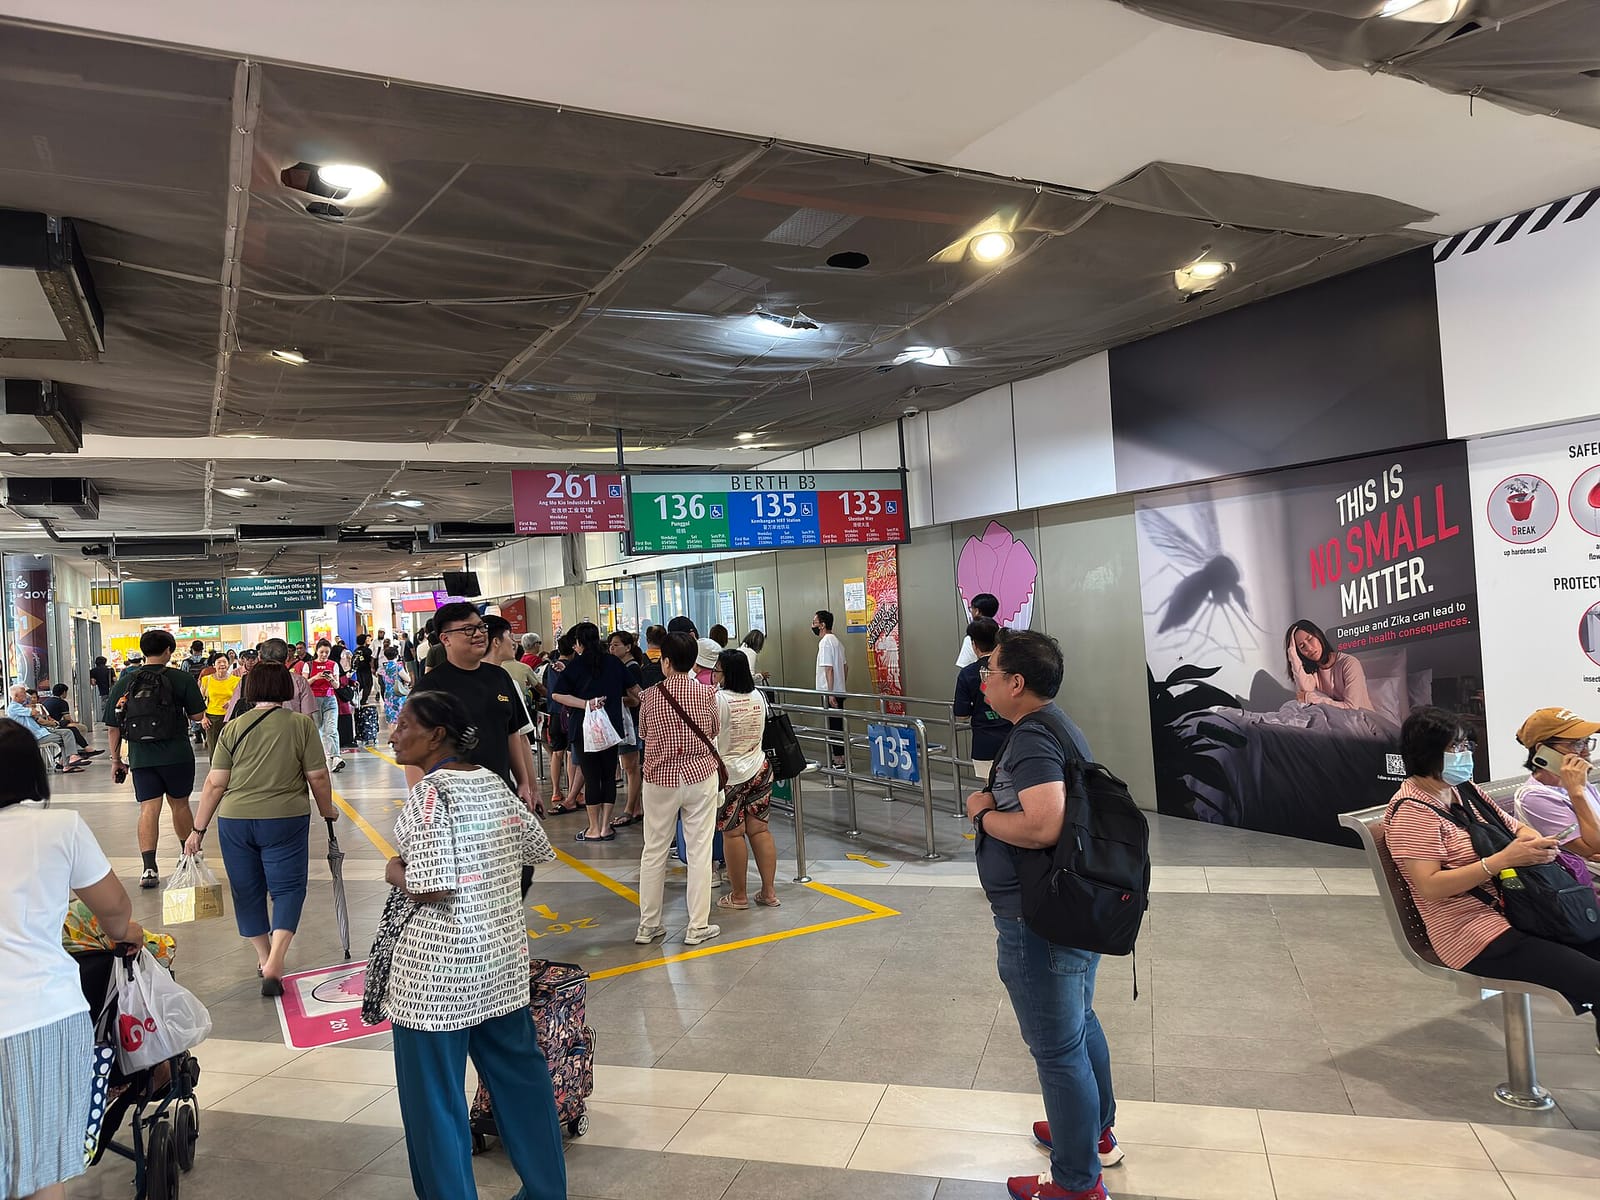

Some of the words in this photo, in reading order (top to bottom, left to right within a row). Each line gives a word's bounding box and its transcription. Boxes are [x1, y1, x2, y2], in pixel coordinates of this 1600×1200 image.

[546, 473, 597, 498] 261
[732, 476, 788, 490] BERTH
[799, 476, 816, 490] B3
[838, 492, 881, 515] 133
[1336, 478, 1377, 526] THIS
[1383, 463, 1404, 504] IS
[654, 494, 705, 520] 136
[752, 493, 796, 517] 135
[1309, 537, 1342, 590] NO
[1348, 484, 1460, 574] SMALL
[1512, 526, 1536, 536] BREAK
[1511, 547, 1536, 555] hardened
[1340, 556, 1434, 618] MATTER.
[1337, 625, 1370, 639] Dengue
[1372, 619, 1389, 631] and
[1391, 615, 1410, 627] Zika
[1413, 612, 1430, 623] can
[1432, 604, 1454, 618] lead
[1456, 602, 1466, 612] to
[1337, 638, 1367, 651] severe
[1368, 632, 1396, 645] health
[1399, 616, 1471, 638] consequences.
[874, 736, 912, 770] 135
[418, 941, 453, 954] CLIMBING
[454, 947, 475, 956] DOWN
[444, 956, 453, 964] NO
[455, 955, 483, 965] MOTHER
[484, 953, 491, 961] OF
[433, 964, 452, 974] LET'S
[455, 966, 473, 974] TURN
[475, 964, 487, 973] THE
[409, 981, 419, 990] NO
[454, 985, 479, 994] ASKING
[443, 975, 478, 984] TROPICAL
[329, 1018, 350, 1033] 261
[415, 1012, 424, 1020] NO
[426, 1011, 477, 1022] PINK-FROSTED
